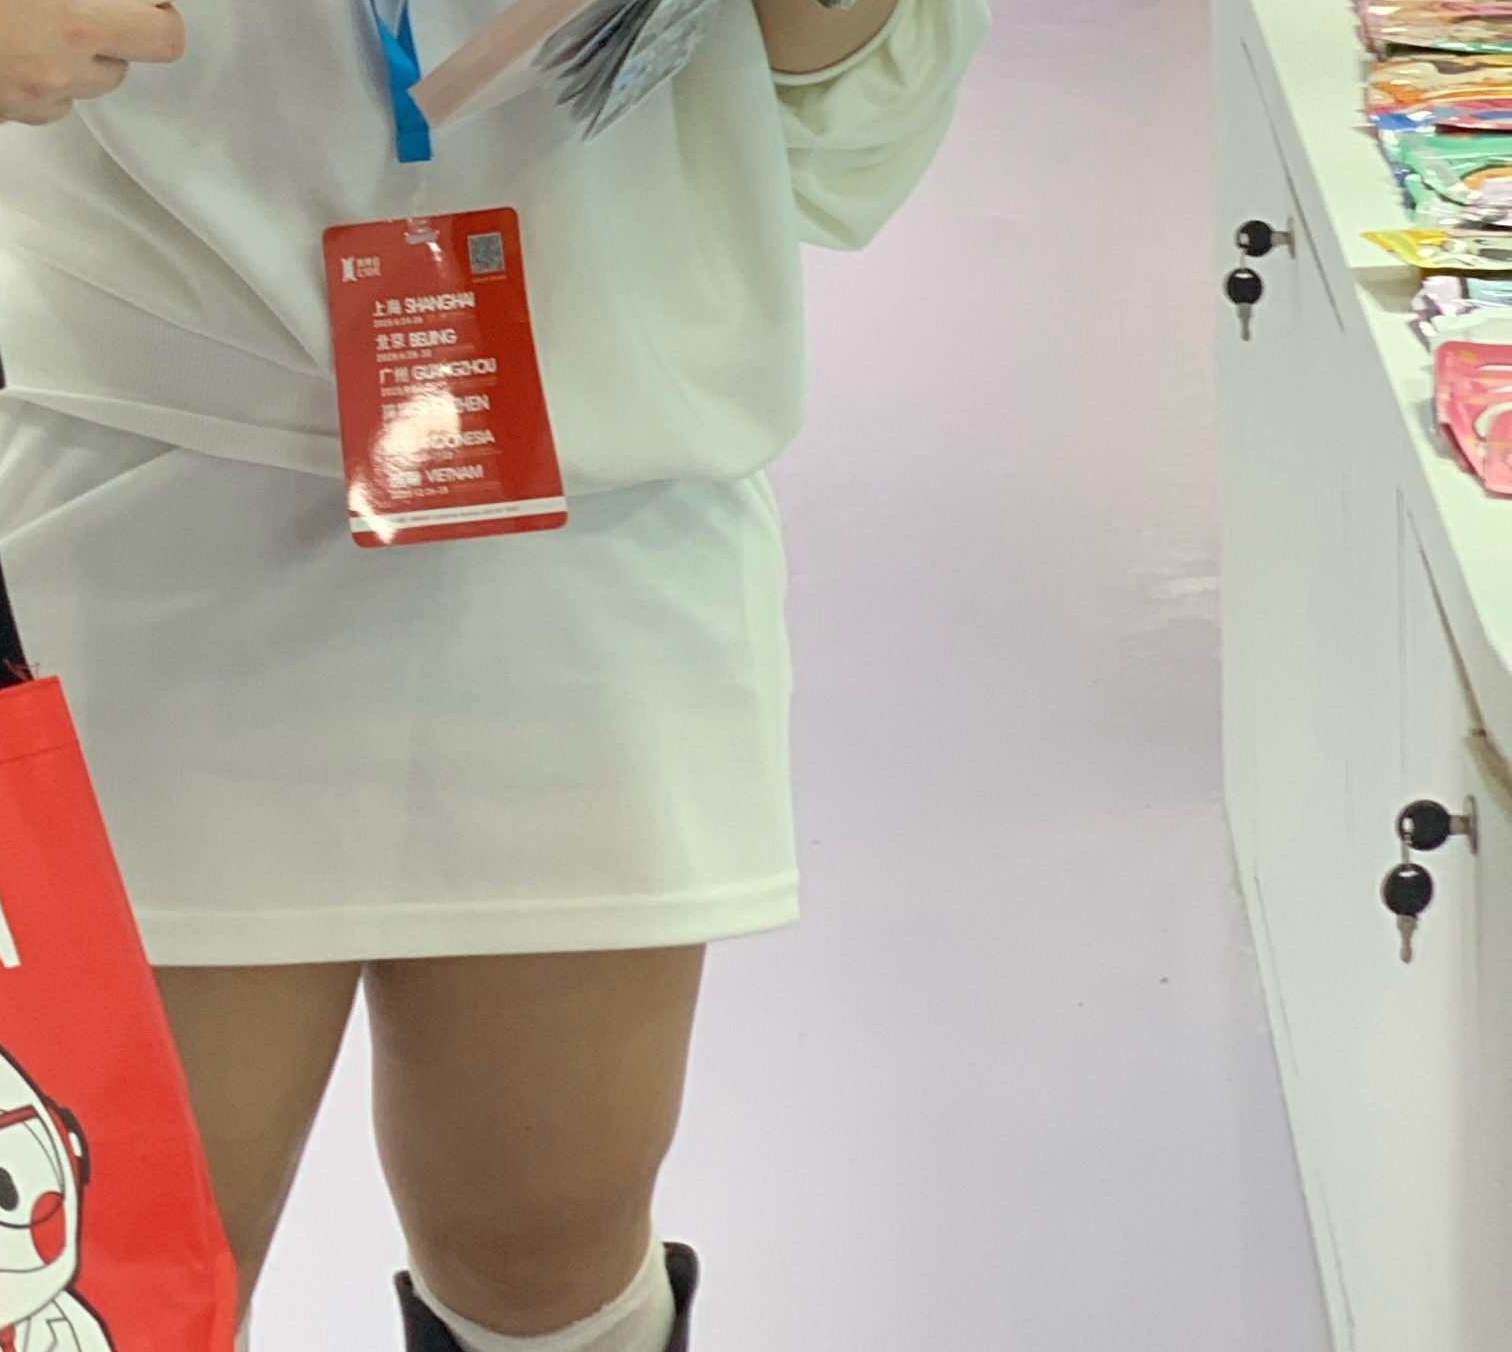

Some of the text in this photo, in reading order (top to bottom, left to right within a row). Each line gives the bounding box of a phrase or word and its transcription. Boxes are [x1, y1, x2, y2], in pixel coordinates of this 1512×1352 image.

[404, 291, 476, 315] SHANGHAI
[409, 328, 458, 347] BEIJING
[411, 357, 497, 381] GUANGZHOU
